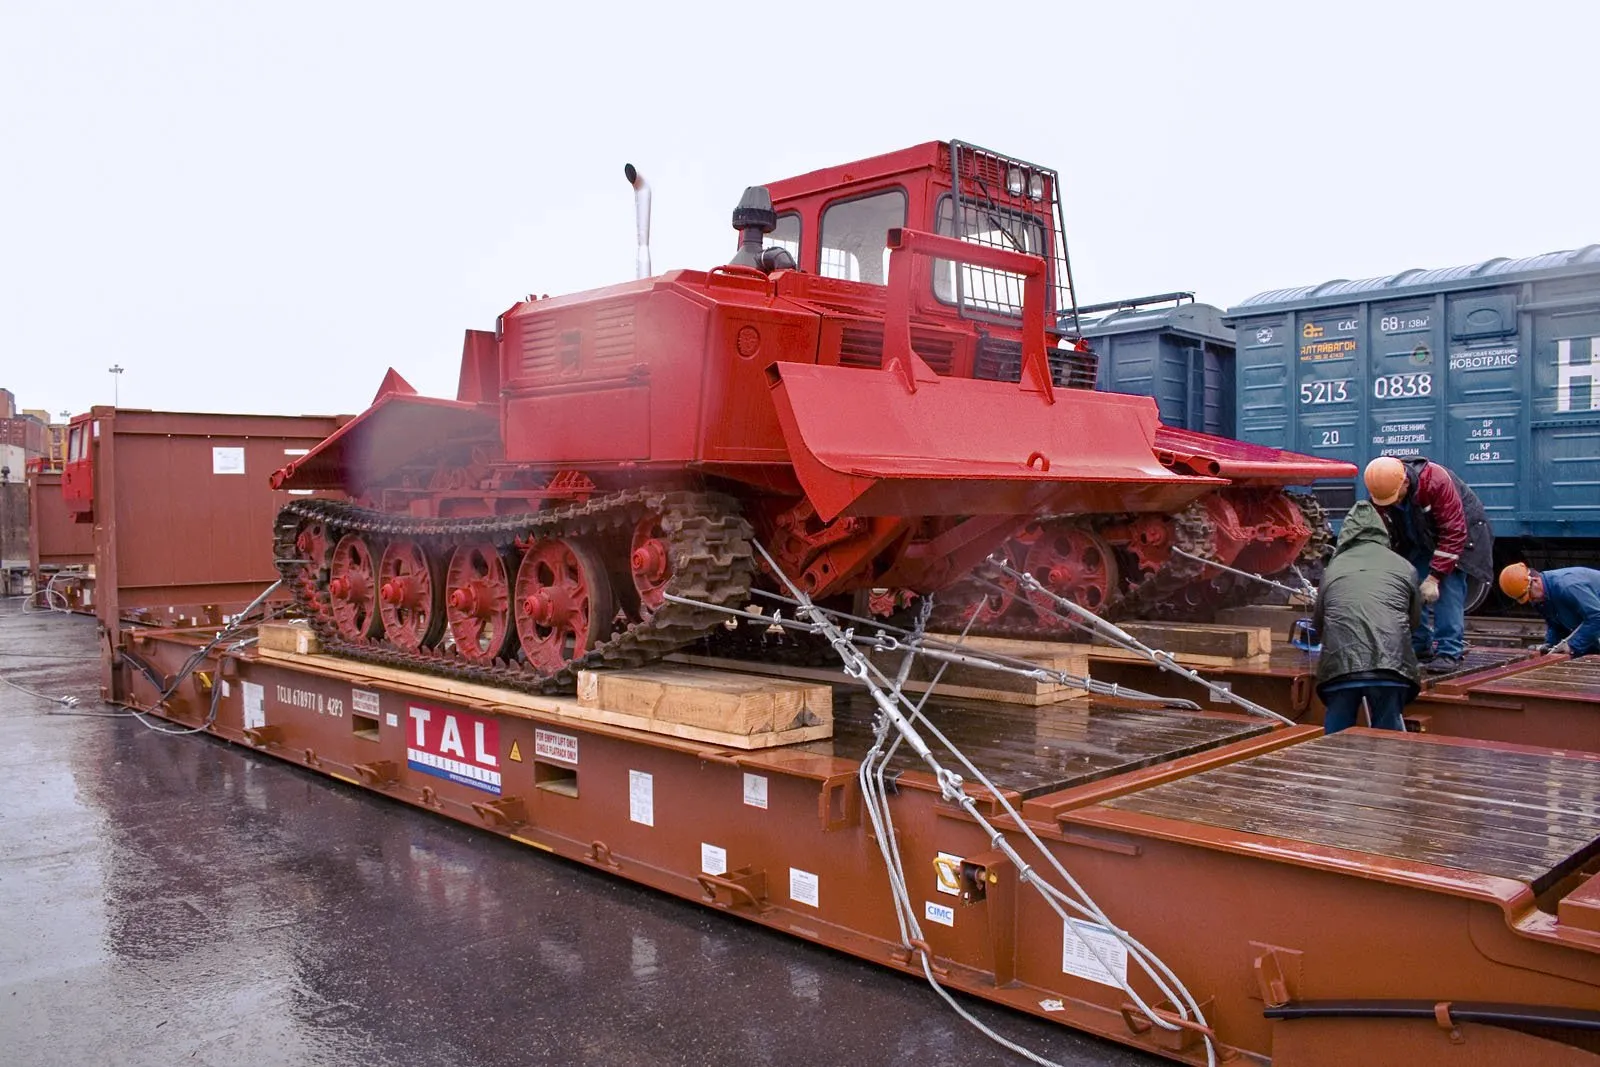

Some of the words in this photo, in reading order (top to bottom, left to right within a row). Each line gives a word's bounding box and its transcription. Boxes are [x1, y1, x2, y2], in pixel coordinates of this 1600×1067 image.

[1381, 316, 1398, 331] 68
[1449, 354, 1518, 370] НОВОТРАНС
[1300, 381, 1347, 404] 5213
[1374, 374, 1432, 399] 0838
[1381, 424, 1426, 433] СОБСТВЕННИК
[1322, 431, 1339, 445] 20
[409, 706, 497, 767] TAL
[927, 905, 952, 920] CIMC
